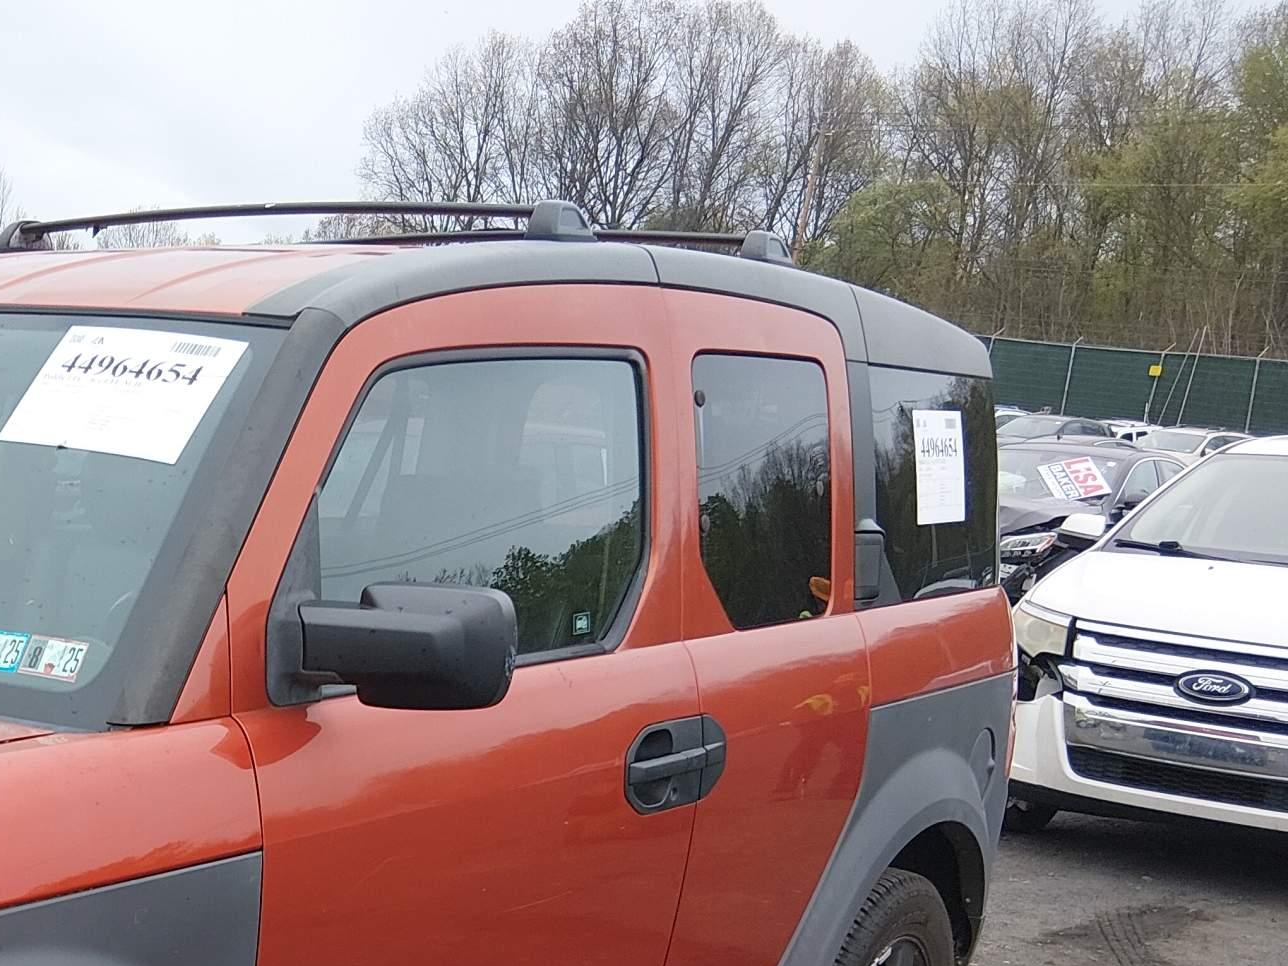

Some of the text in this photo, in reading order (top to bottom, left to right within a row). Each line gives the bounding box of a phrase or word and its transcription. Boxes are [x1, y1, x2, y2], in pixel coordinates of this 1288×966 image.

[62, 352, 204, 386] 44964654
[921, 437, 958, 458] 44964654
[1049, 464, 1081, 499] BAKER
[62, 647, 84, 674] 25
[1192, 676, 1232, 694] Ford
